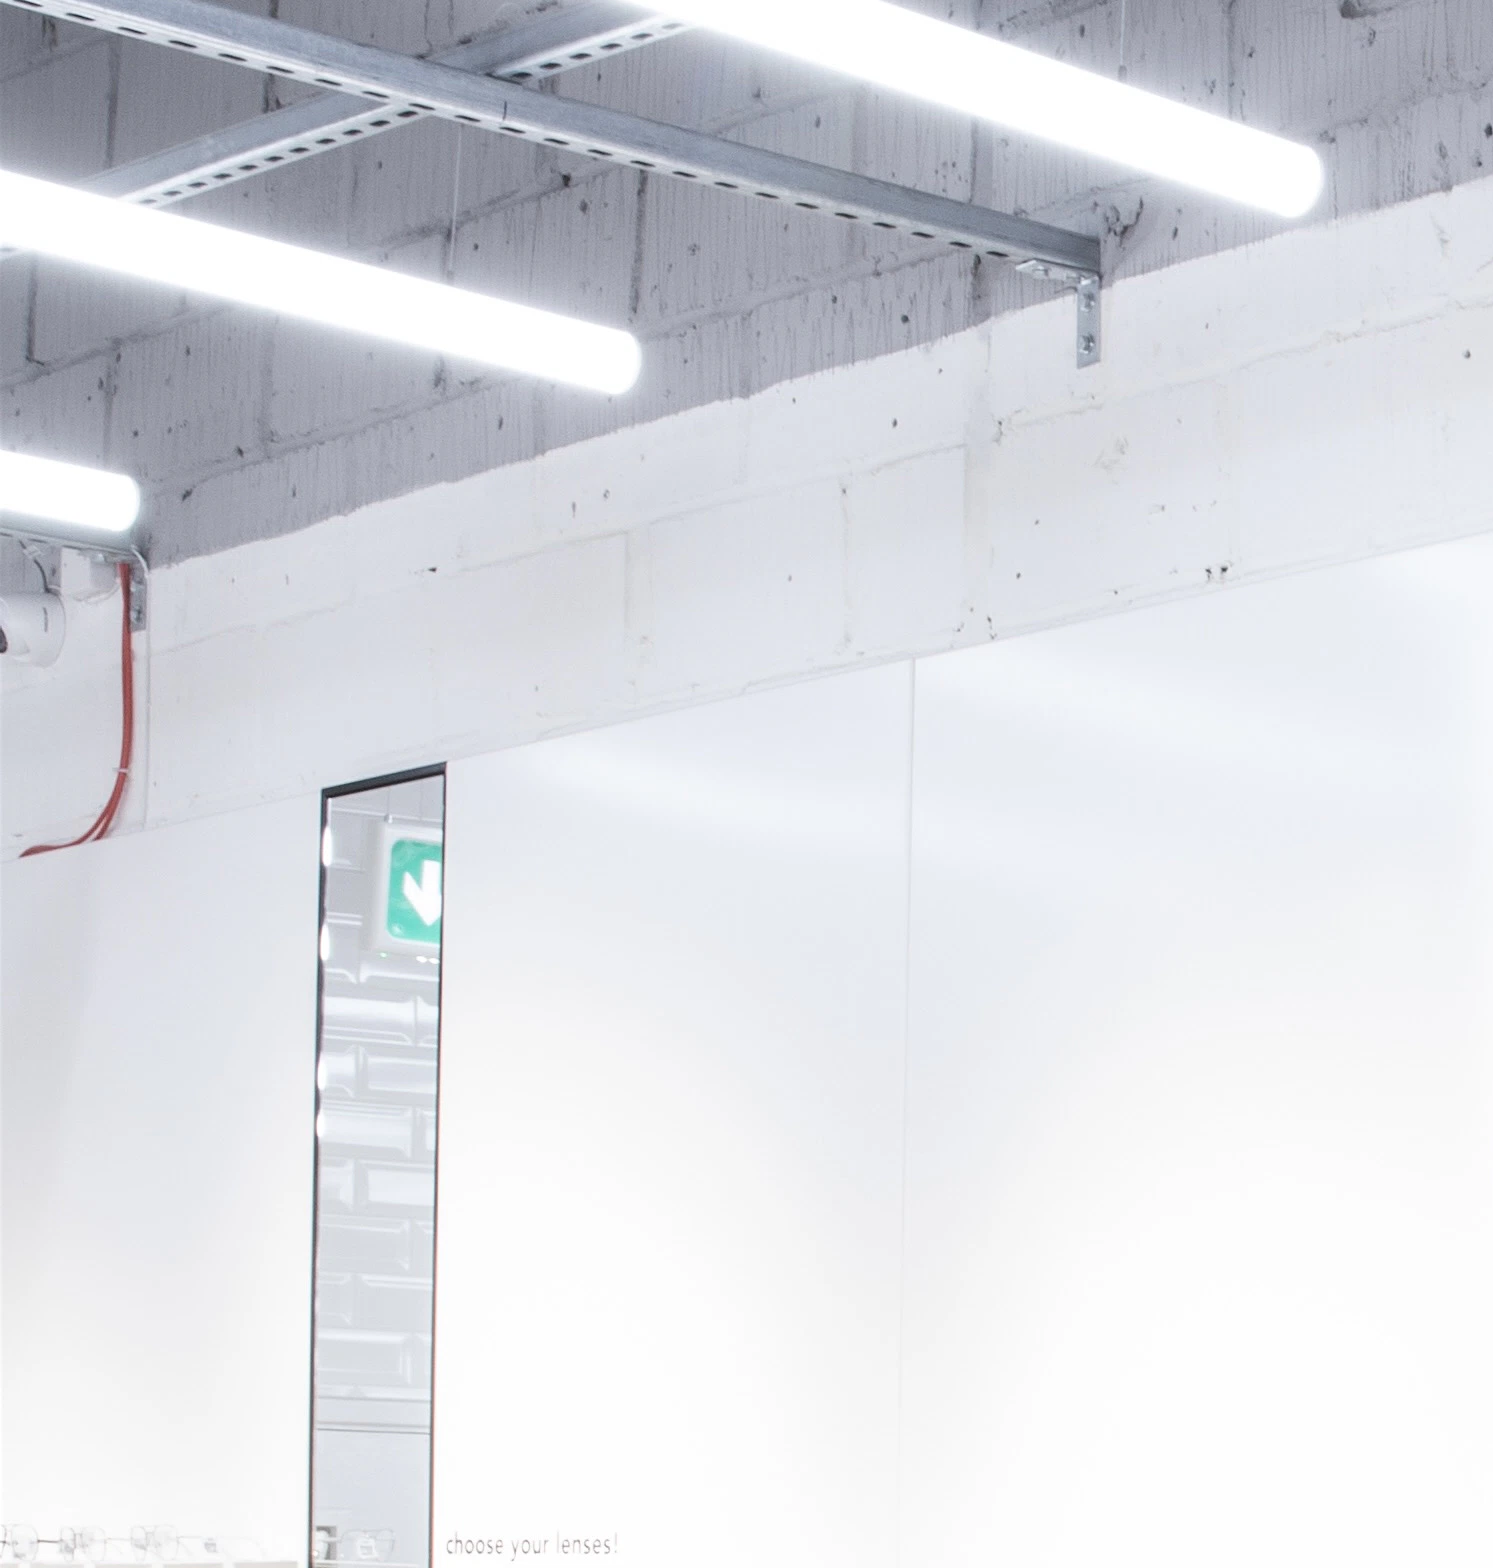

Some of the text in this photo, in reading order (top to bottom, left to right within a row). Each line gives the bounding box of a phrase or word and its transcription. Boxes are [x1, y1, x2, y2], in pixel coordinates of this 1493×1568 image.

[446, 1530, 618, 1562] choose your lenses!
